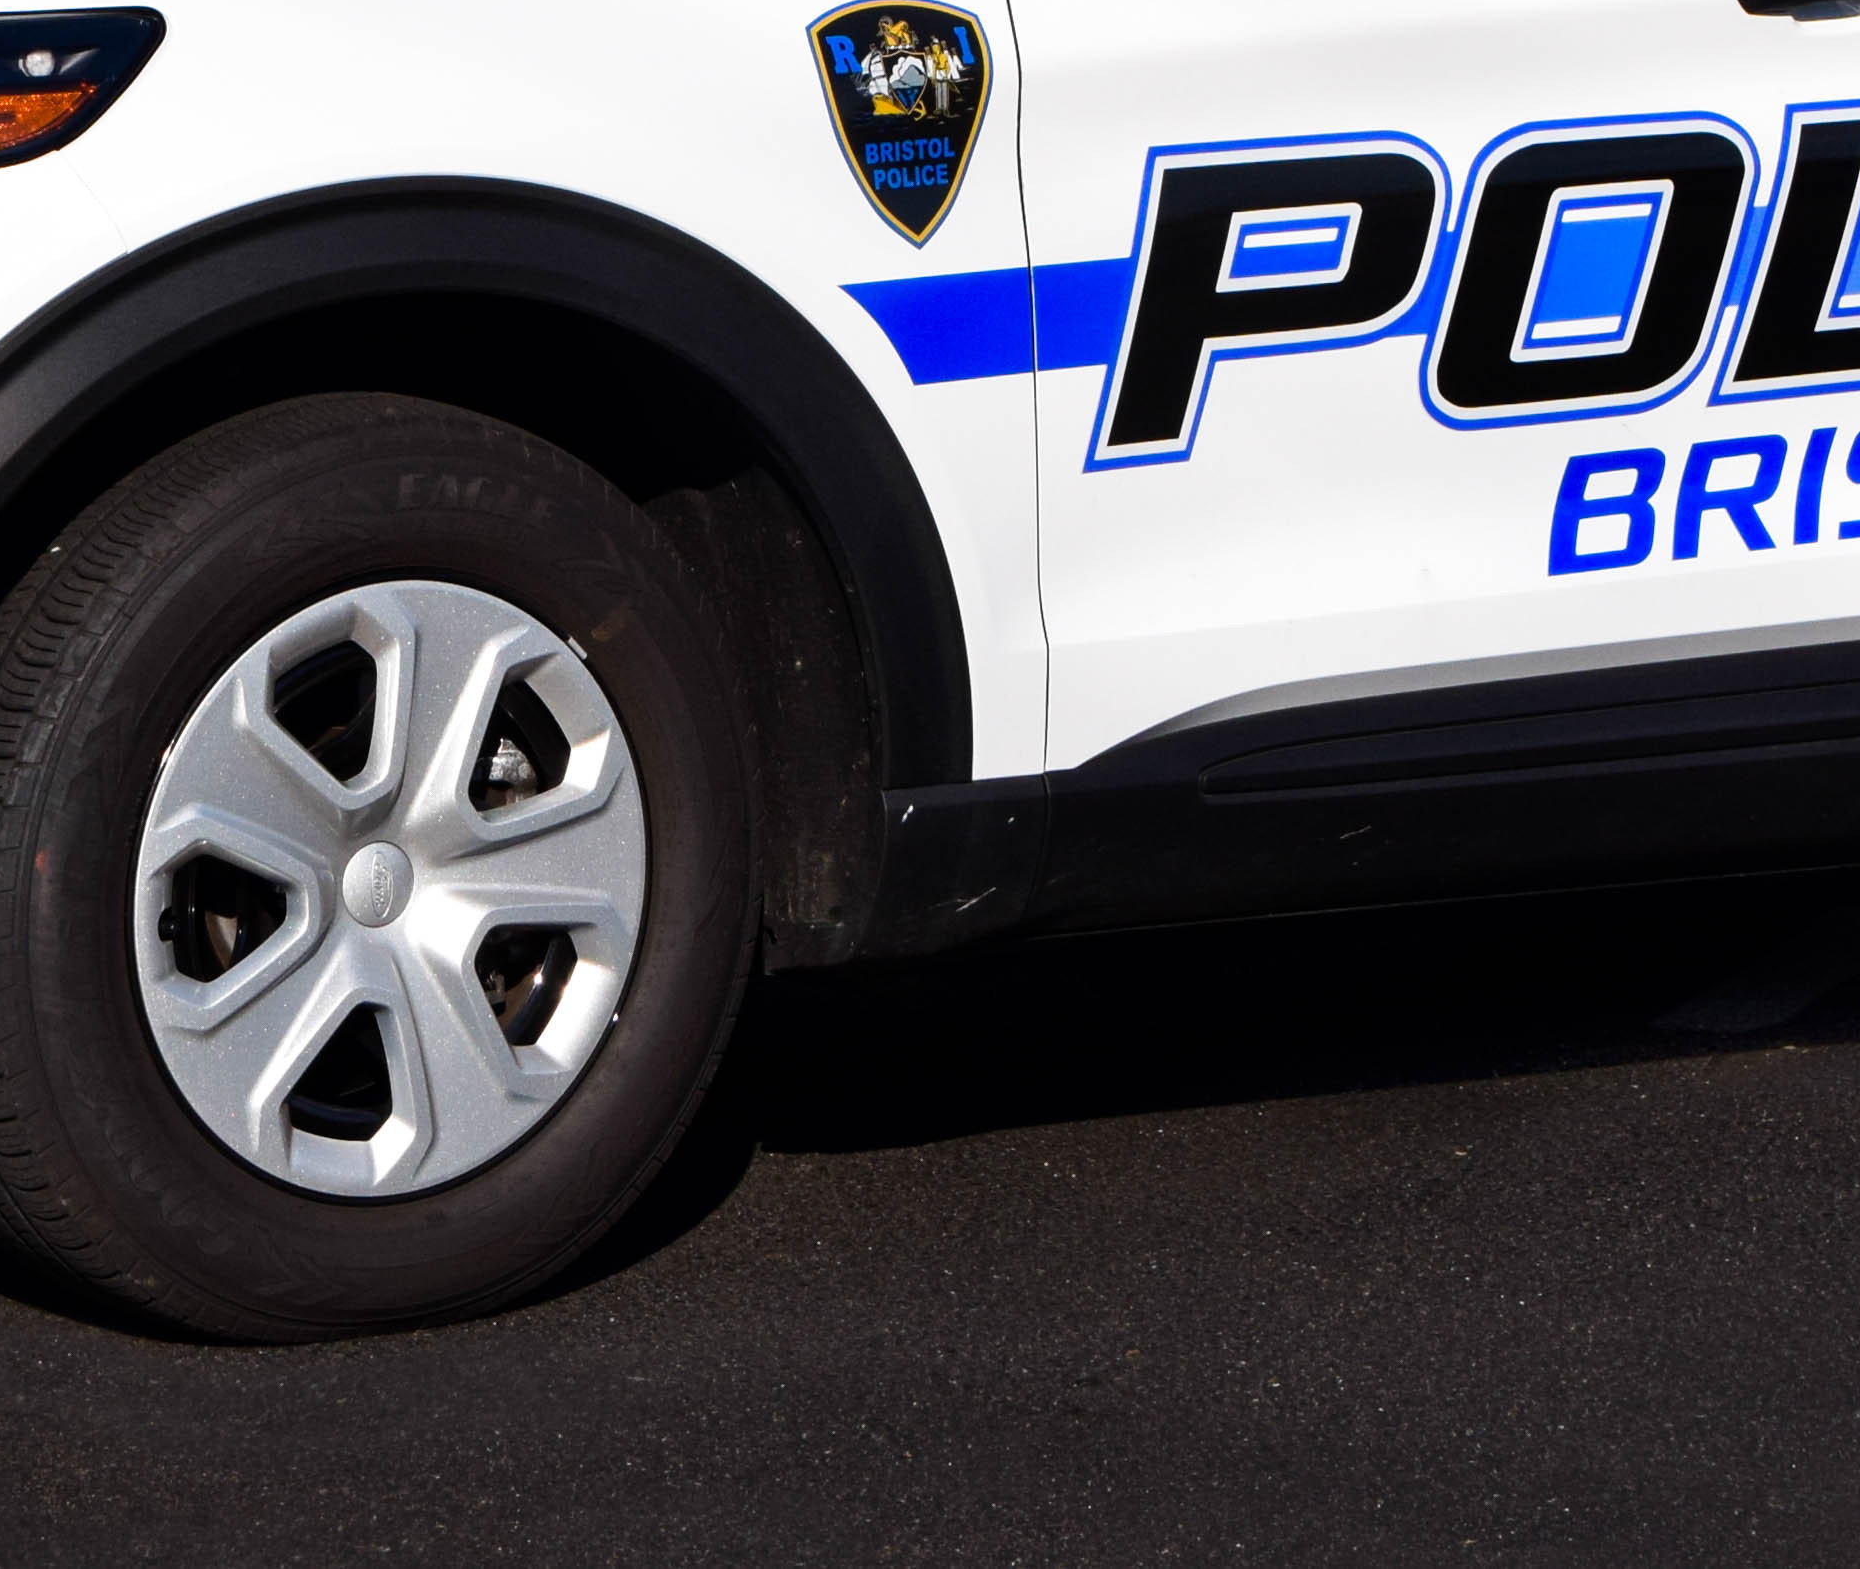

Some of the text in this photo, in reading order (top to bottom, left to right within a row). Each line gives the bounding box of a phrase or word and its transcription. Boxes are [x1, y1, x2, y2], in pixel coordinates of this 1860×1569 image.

[826, 35, 862, 75] R
[866, 138, 955, 164] BRISTOL
[874, 165, 948, 190] POLICE
